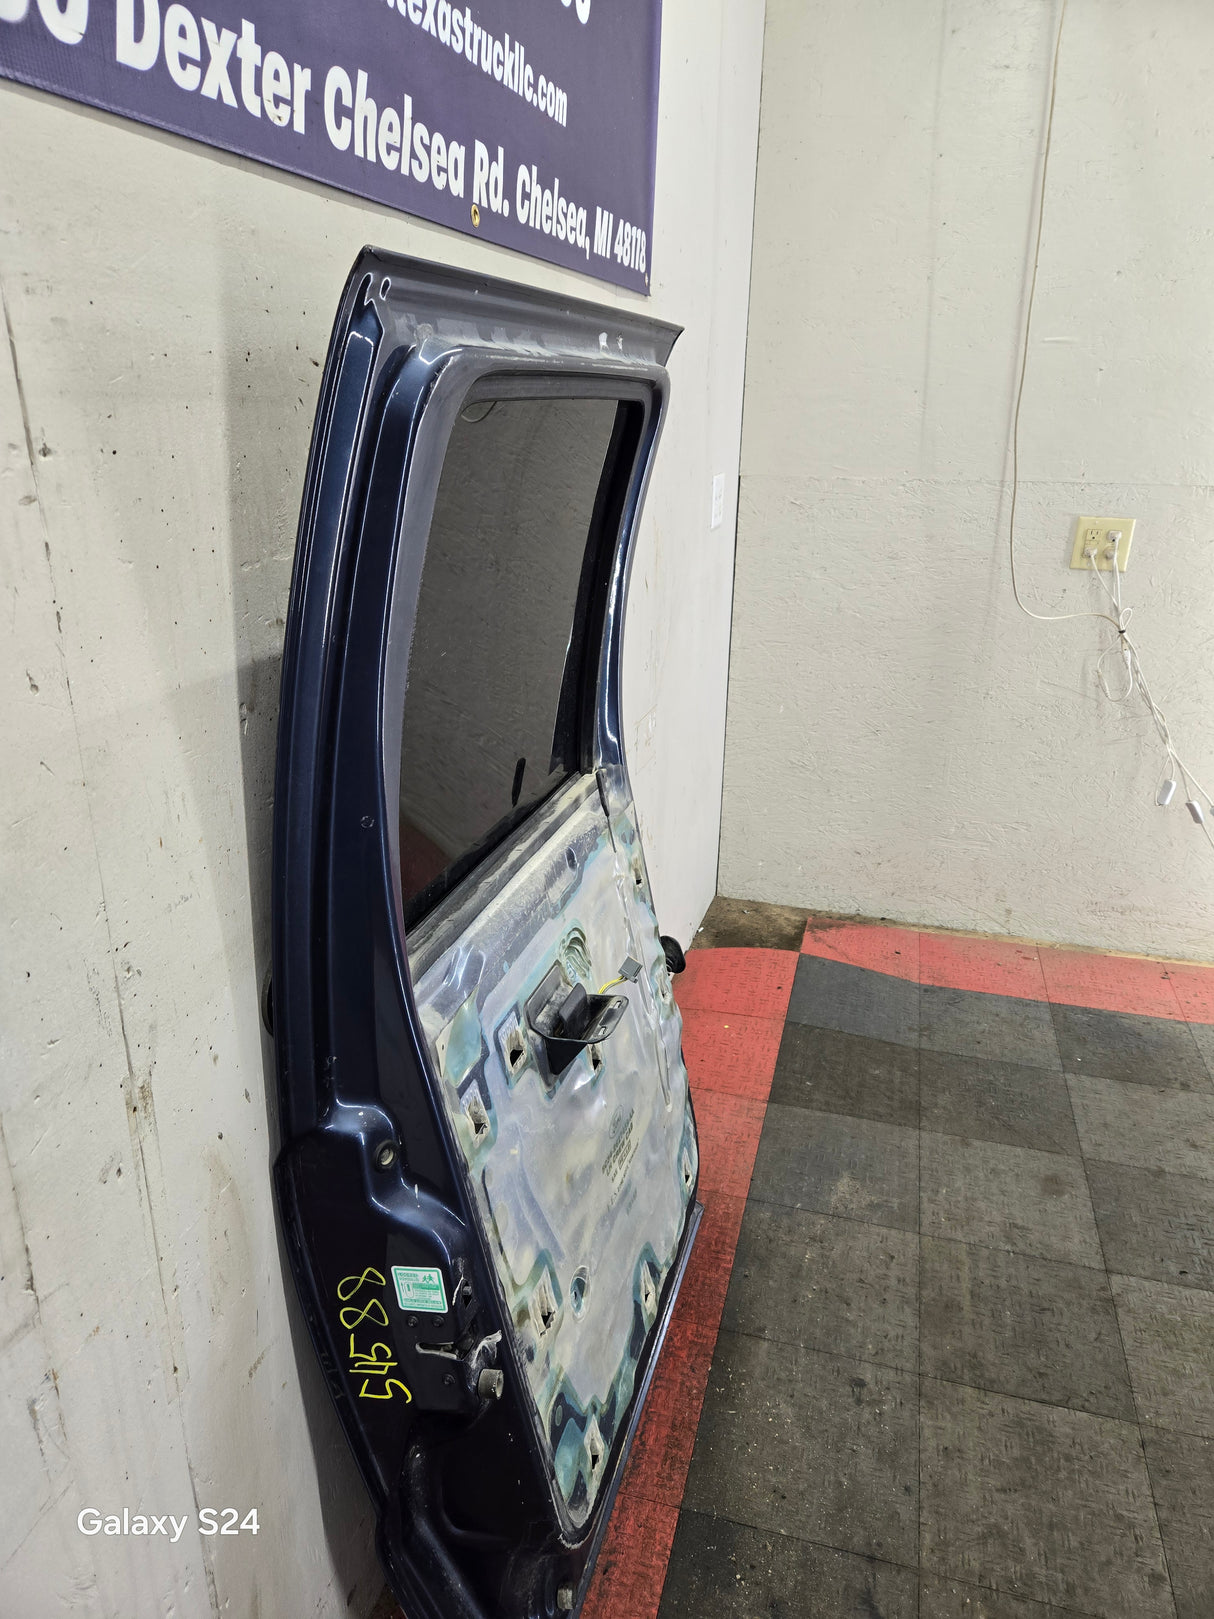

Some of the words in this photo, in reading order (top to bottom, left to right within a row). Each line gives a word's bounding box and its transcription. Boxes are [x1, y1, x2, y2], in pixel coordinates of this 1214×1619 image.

[116, 0, 312, 135] Dexter
[324, 65, 466, 198] Chelsea
[472, 139, 510, 217] Rd.
[516, 164, 590, 260] Chelsea,
[593, 206, 614, 259] MI
[614, 219, 647, 273] 48118
[387, 0, 568, 127] exastruckllc.com
